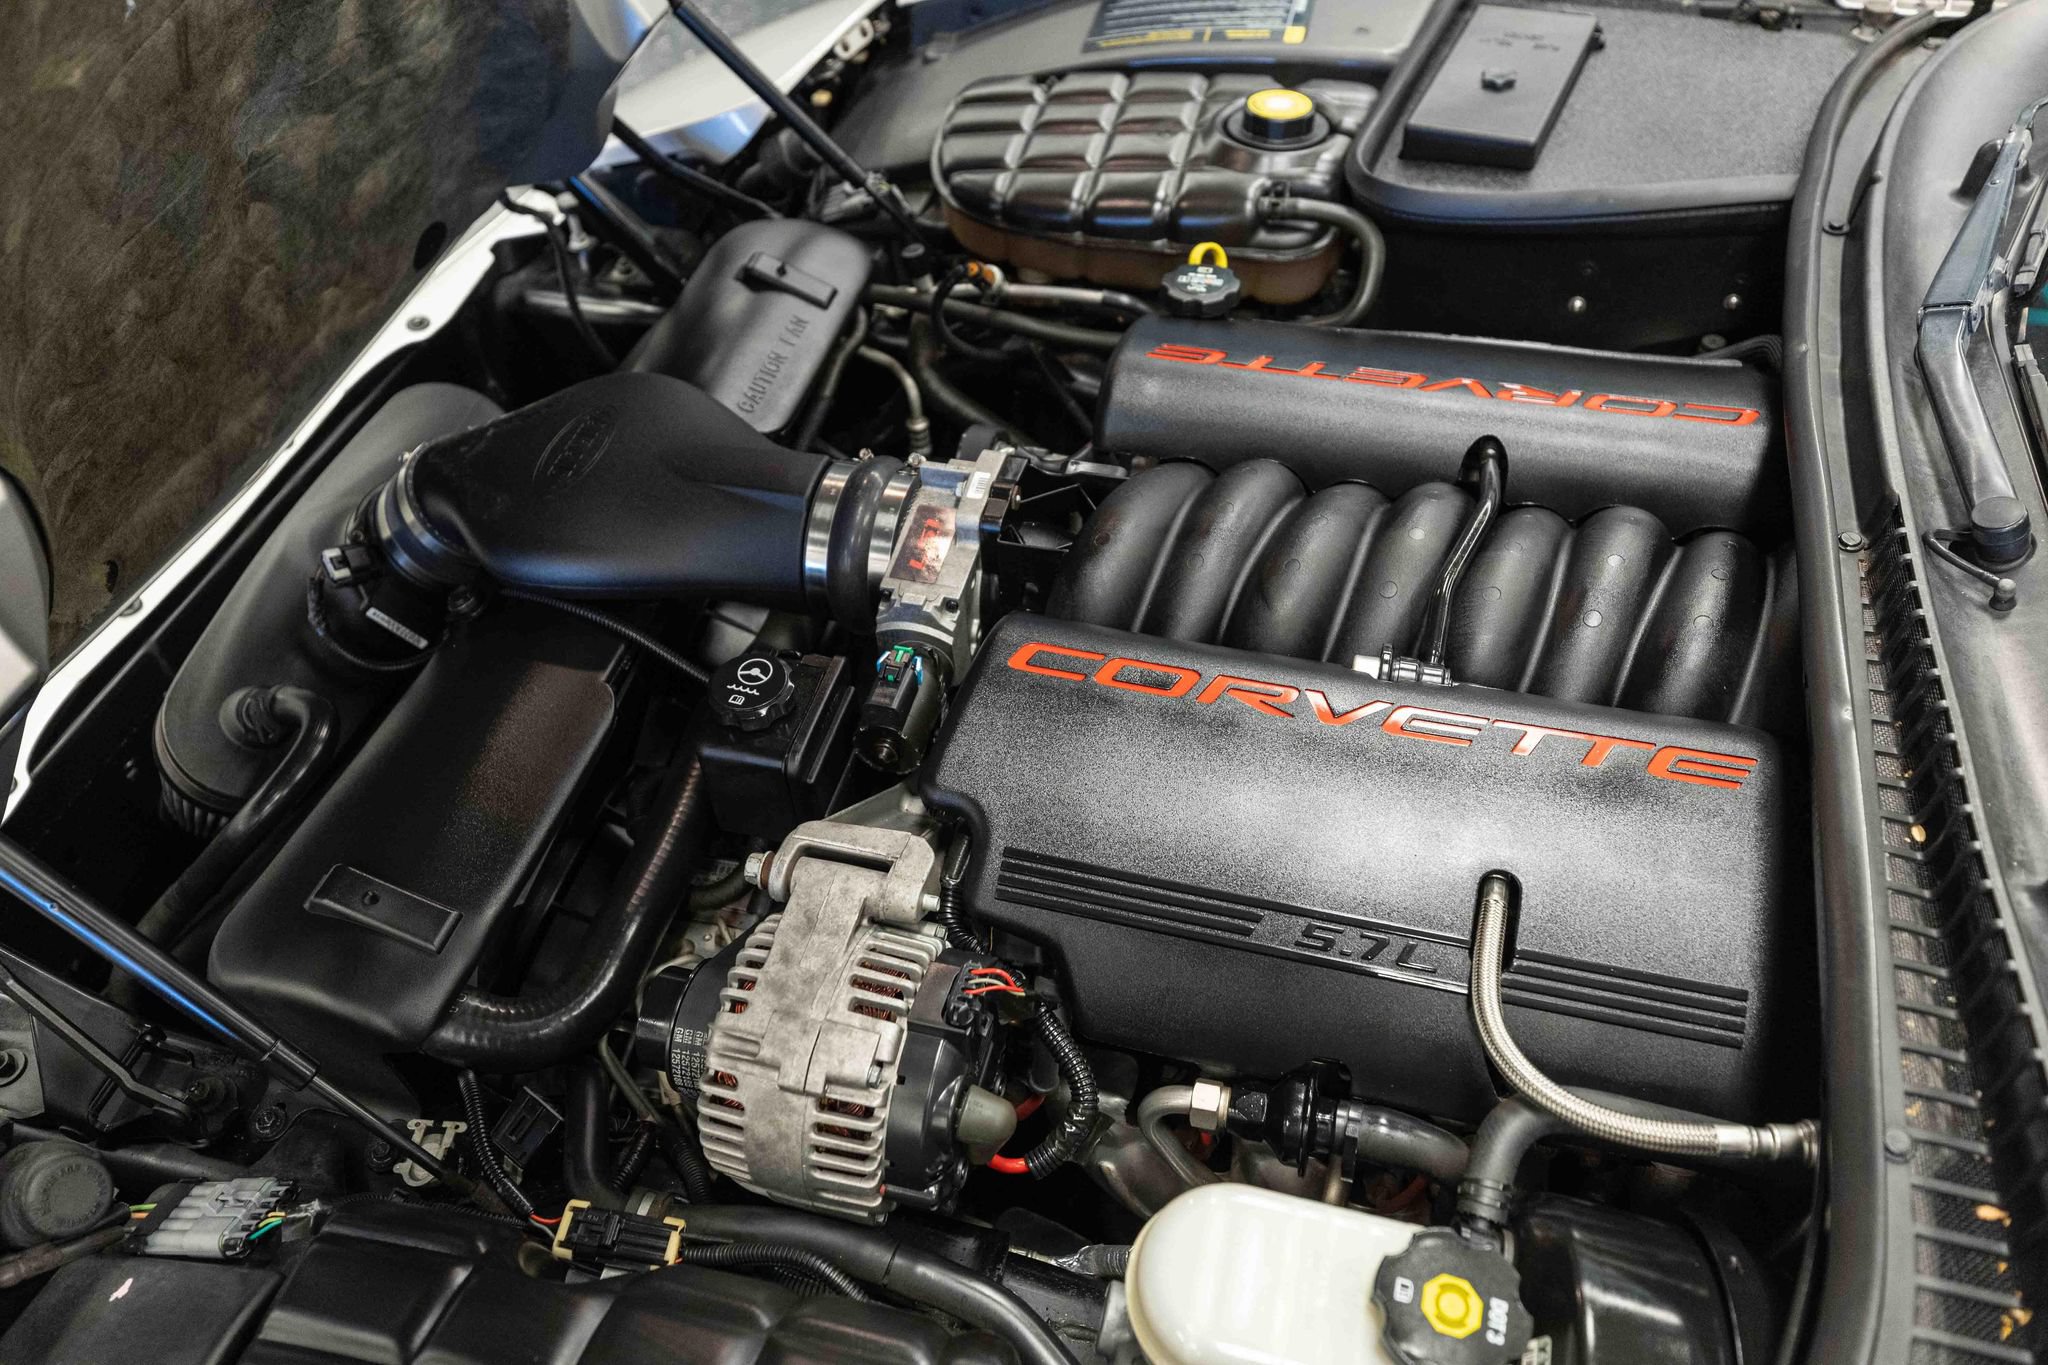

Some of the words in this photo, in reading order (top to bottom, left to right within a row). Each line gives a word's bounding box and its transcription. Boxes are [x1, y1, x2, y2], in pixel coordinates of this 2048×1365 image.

[737, 350, 788, 413] CAUTION
[1145, 343, 1761, 426] CORVETTE
[1007, 642, 1759, 790] CORVETTE
[1294, 922, 1437, 973] 5.7L
[674, 1027, 684, 1043] GM
[684, 1029, 694, 1045] GM
[694, 1031, 704, 1046] GM
[1487, 1296, 1509, 1334] DOT
